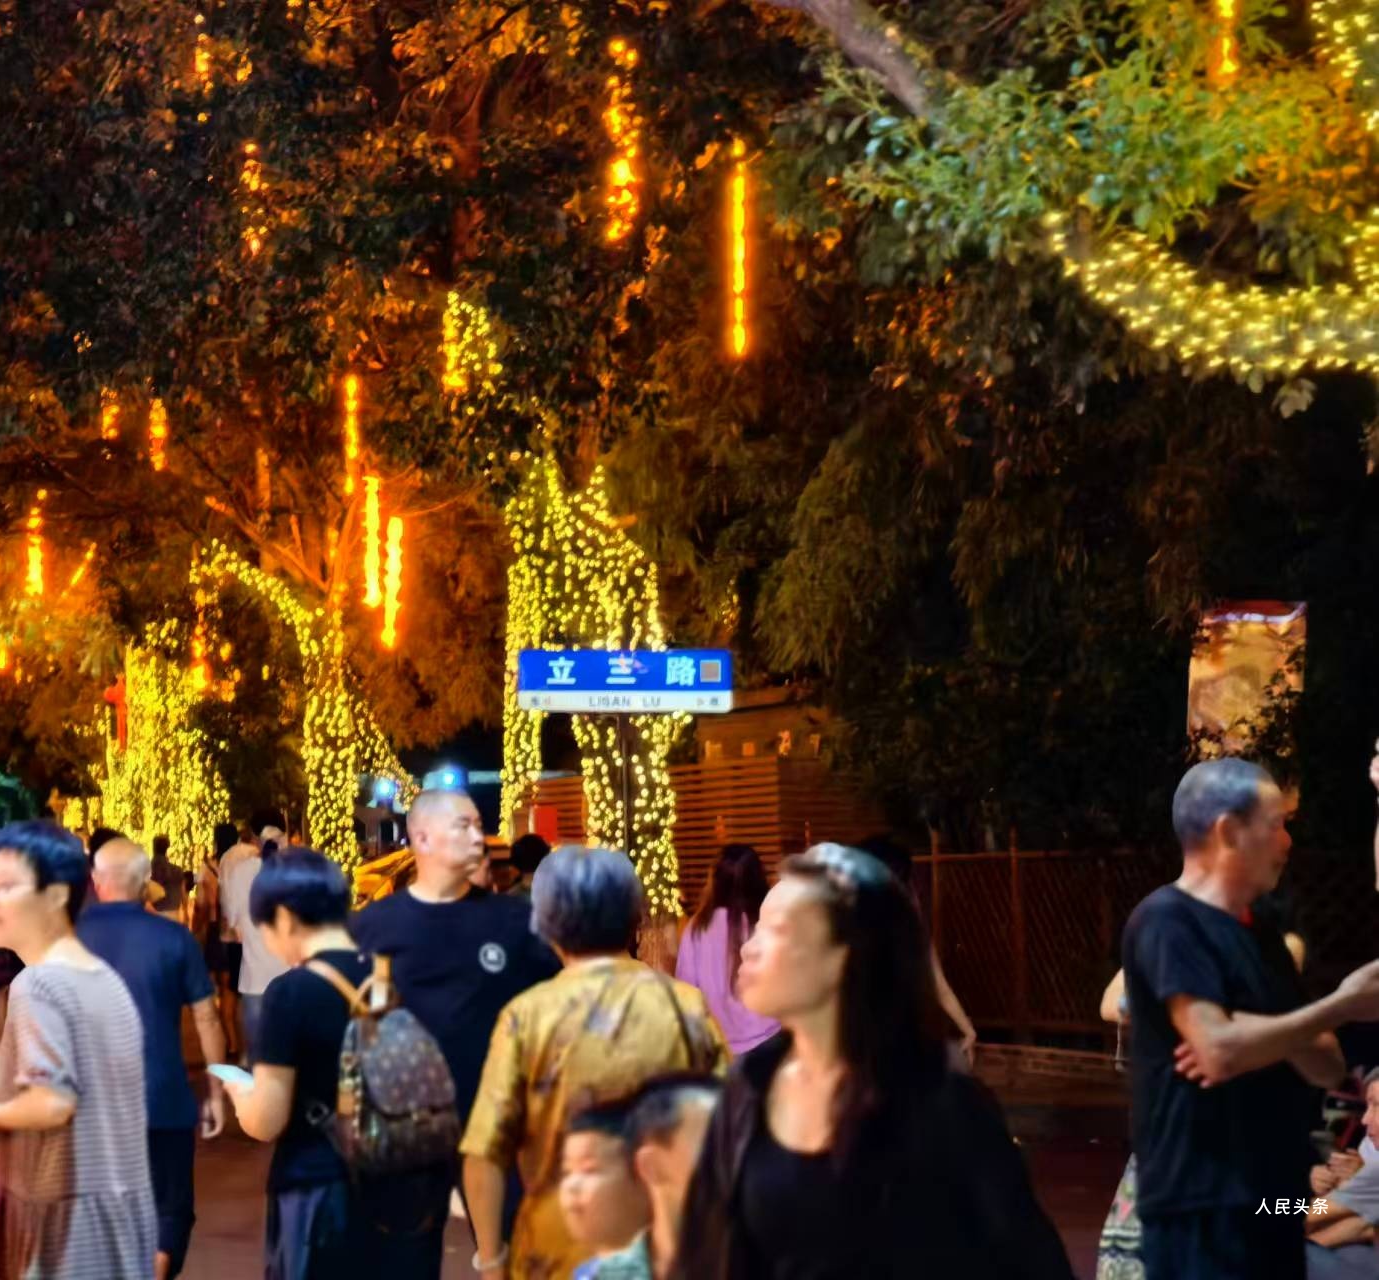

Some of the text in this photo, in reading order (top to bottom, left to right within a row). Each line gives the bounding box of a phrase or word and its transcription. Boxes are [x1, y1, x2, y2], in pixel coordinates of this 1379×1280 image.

[546, 656, 696, 686] 立三路
[588, 695, 661, 707] LISAN LU
